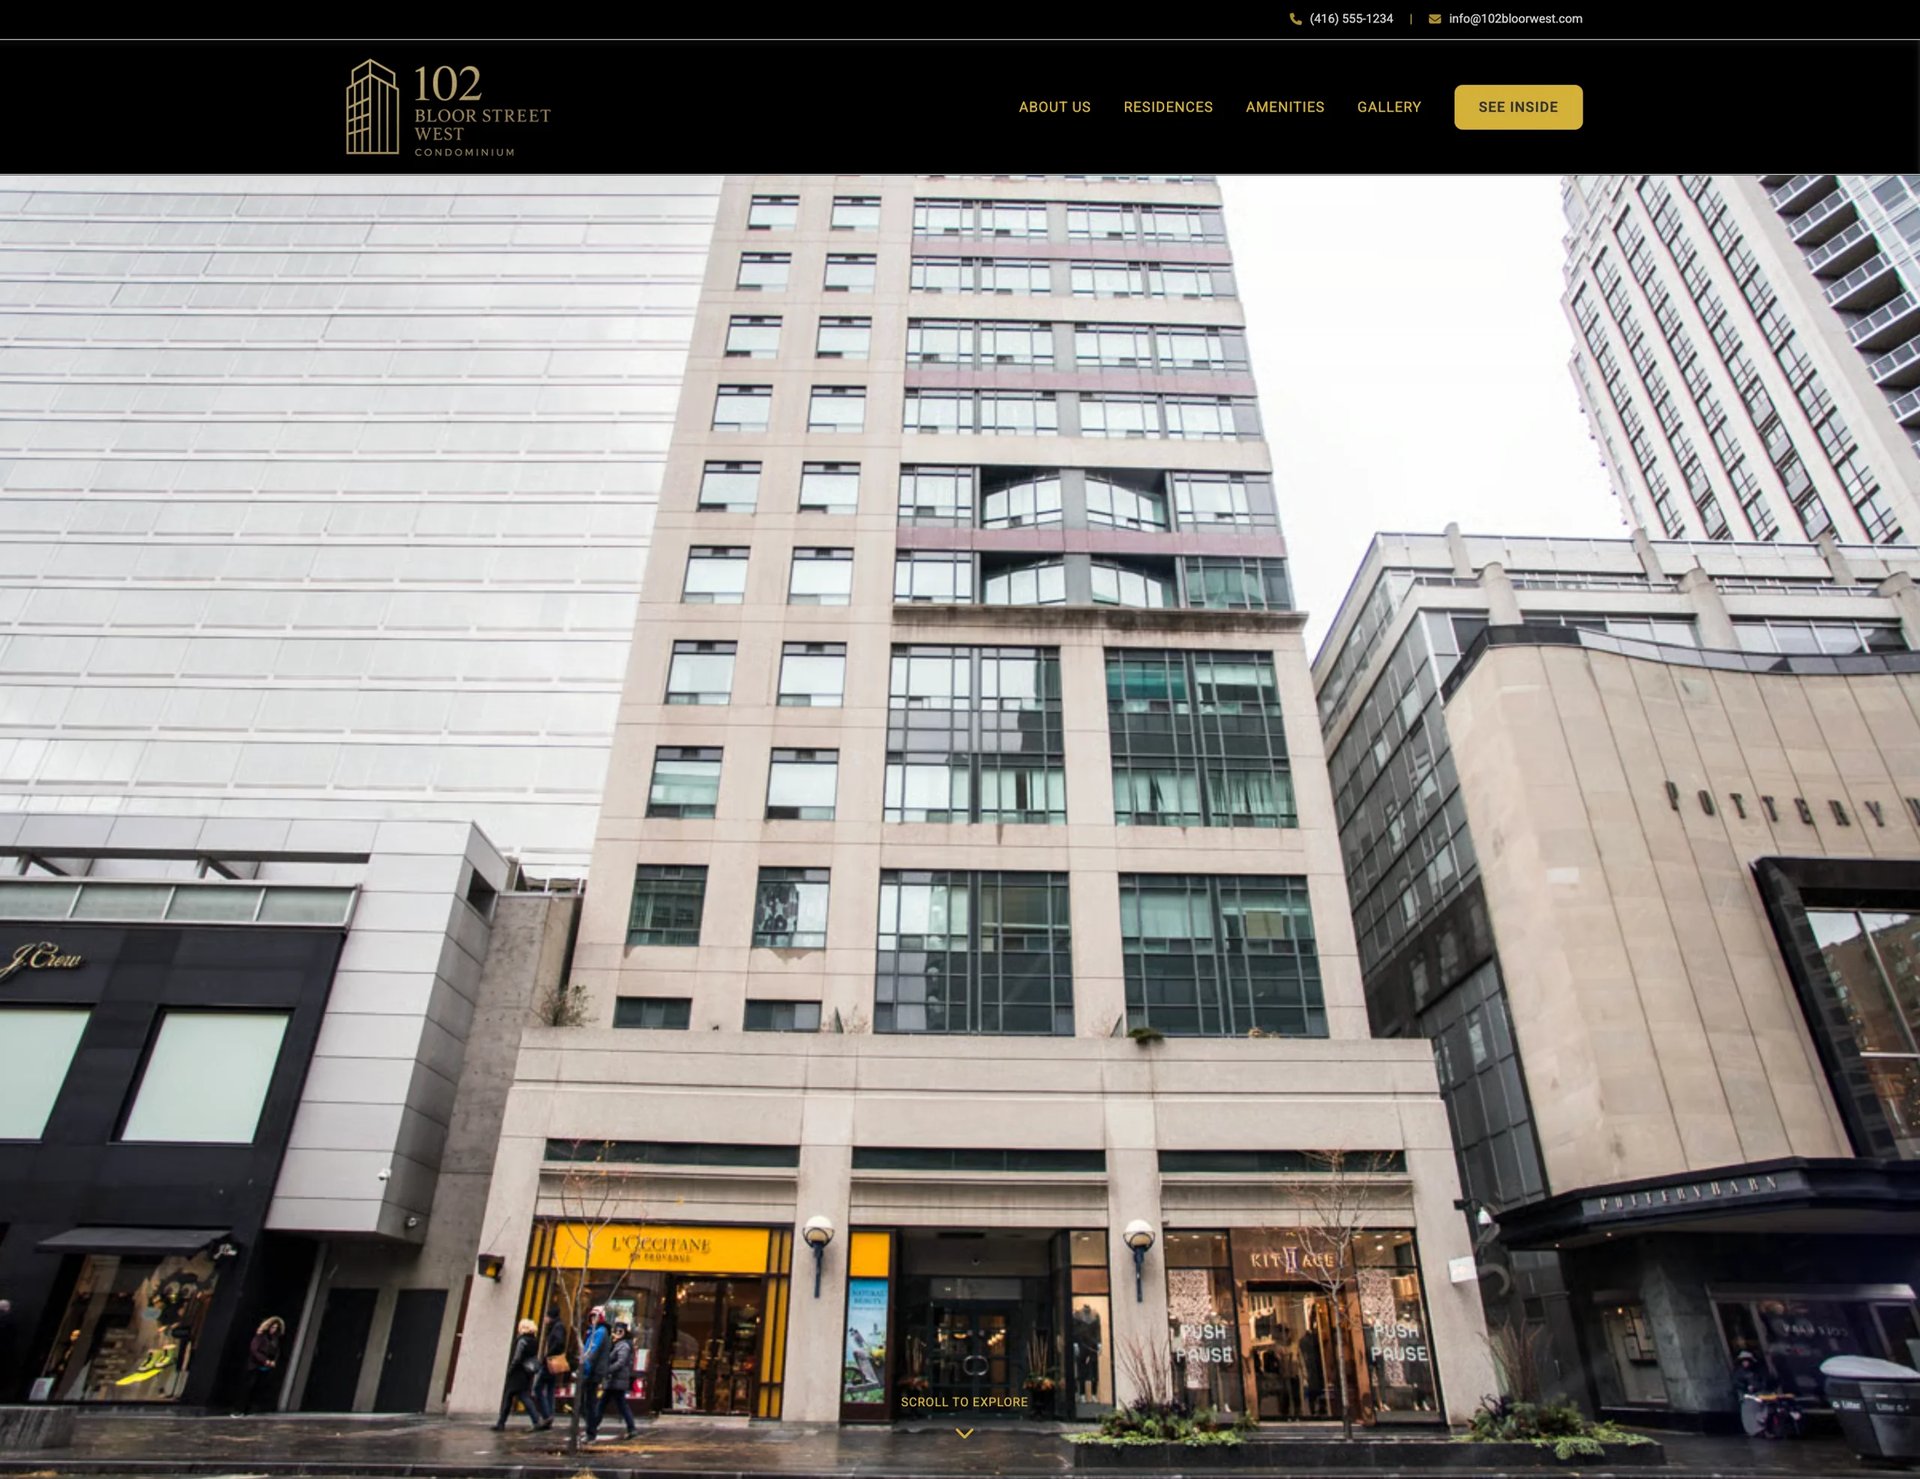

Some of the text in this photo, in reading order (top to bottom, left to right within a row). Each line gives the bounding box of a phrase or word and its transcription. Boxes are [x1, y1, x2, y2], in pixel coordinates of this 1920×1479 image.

[612, 1235, 711, 1254] L'OCCITANE
[1250, 1252, 1280, 1268] KIT
[1180, 1324, 1227, 1340] PUSH
[1374, 1323, 1420, 1339] PUSH
[1176, 1346, 1234, 1363] PAUSE
[1371, 1345, 1429, 1362] PAUSE
